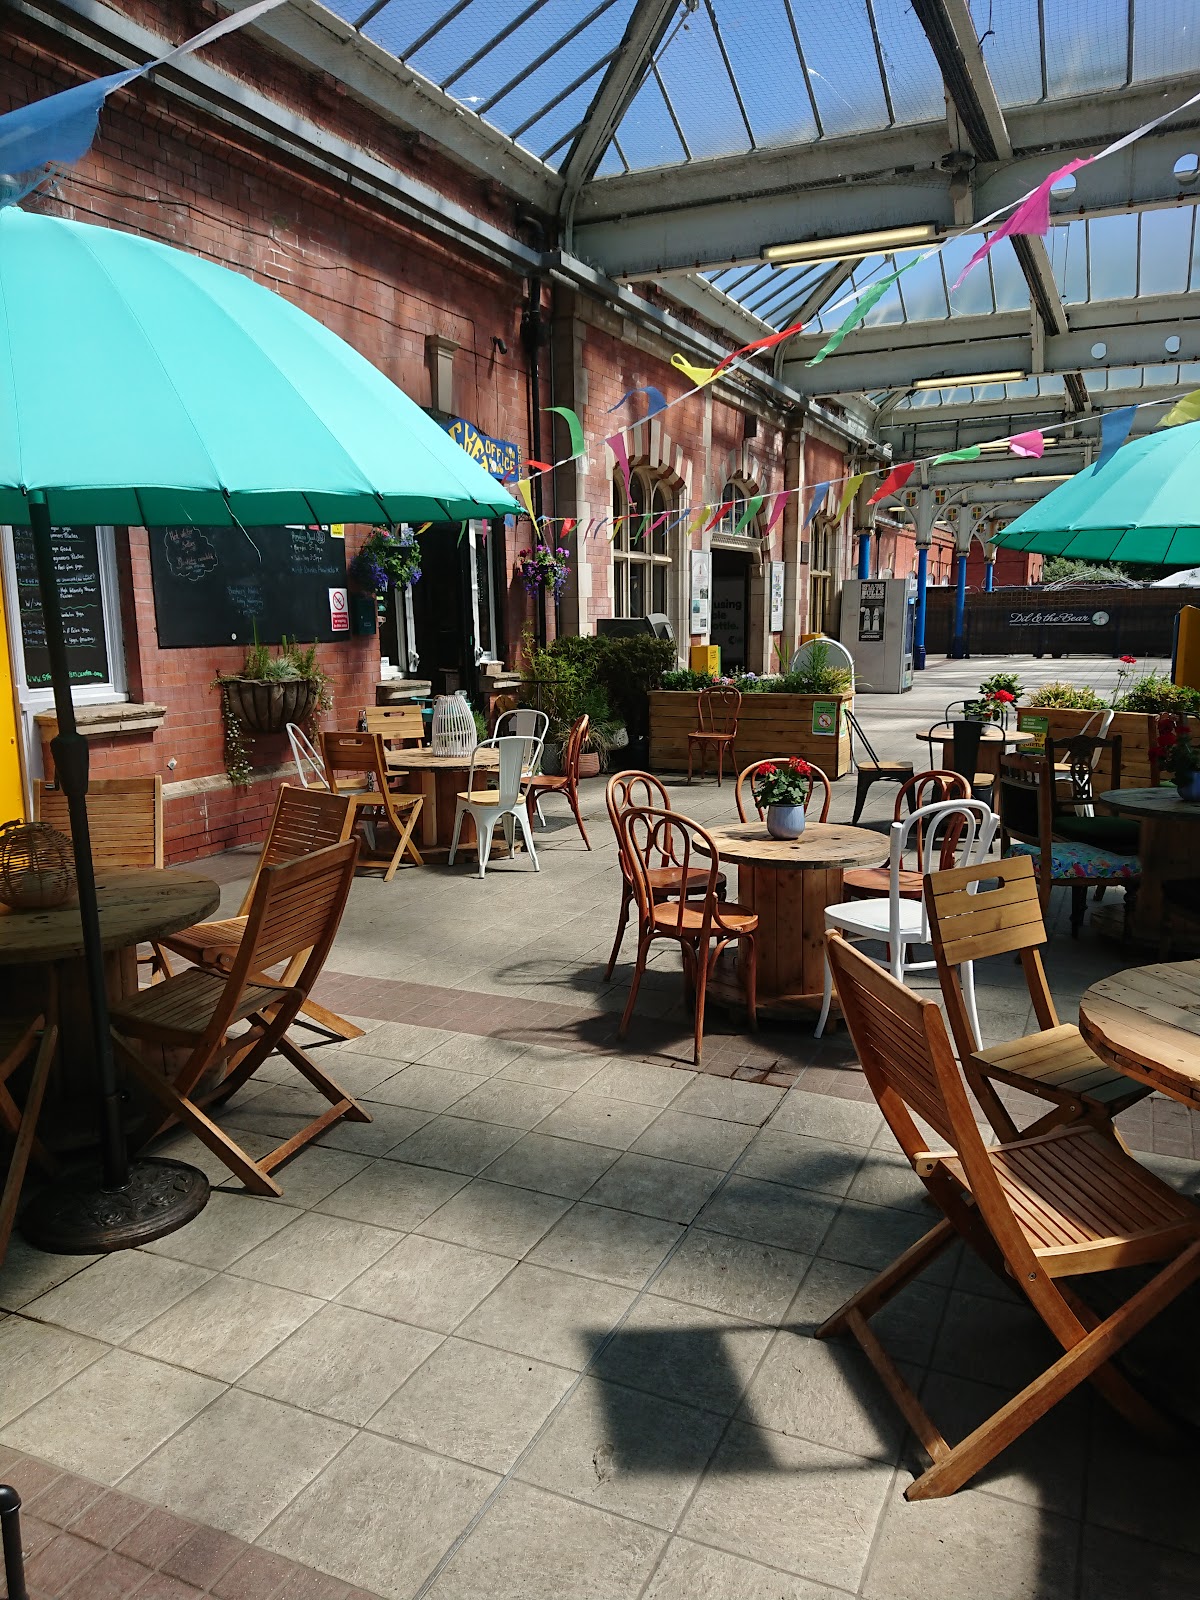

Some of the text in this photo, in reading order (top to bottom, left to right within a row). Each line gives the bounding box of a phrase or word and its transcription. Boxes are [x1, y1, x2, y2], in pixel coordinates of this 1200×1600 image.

[485, 439, 516, 475] OFFICE
[713, 599, 742, 611] using
[1042, 612, 1060, 622] the
[1059, 612, 1090, 623] Bear
[712, 620, 739, 630] ottle.
